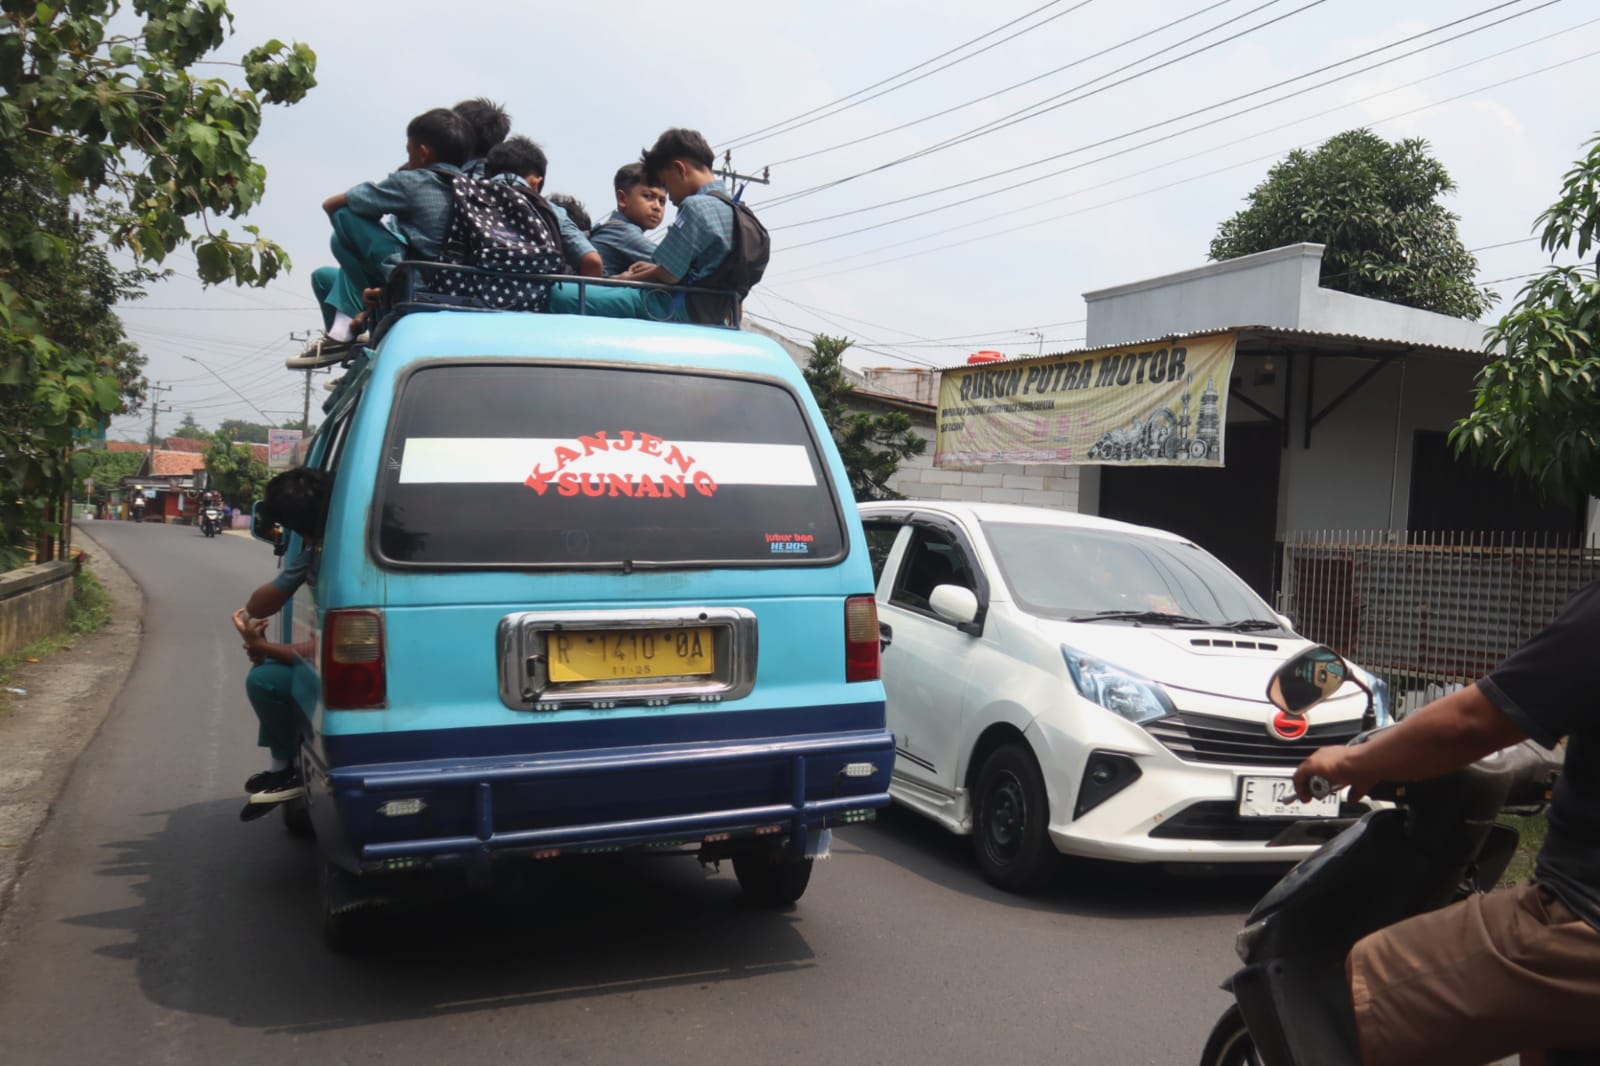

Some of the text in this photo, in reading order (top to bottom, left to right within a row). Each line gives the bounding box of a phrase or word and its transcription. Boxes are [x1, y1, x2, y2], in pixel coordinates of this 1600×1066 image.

[960, 348, 1187, 401] RUKUN PUTRA MOTOR
[524, 431, 718, 496] KANJENG
[557, 473, 686, 498] SUNAN
[557, 635, 570, 663] R
[599, 632, 655, 662] 1410
[1246, 781, 1254, 802] E
